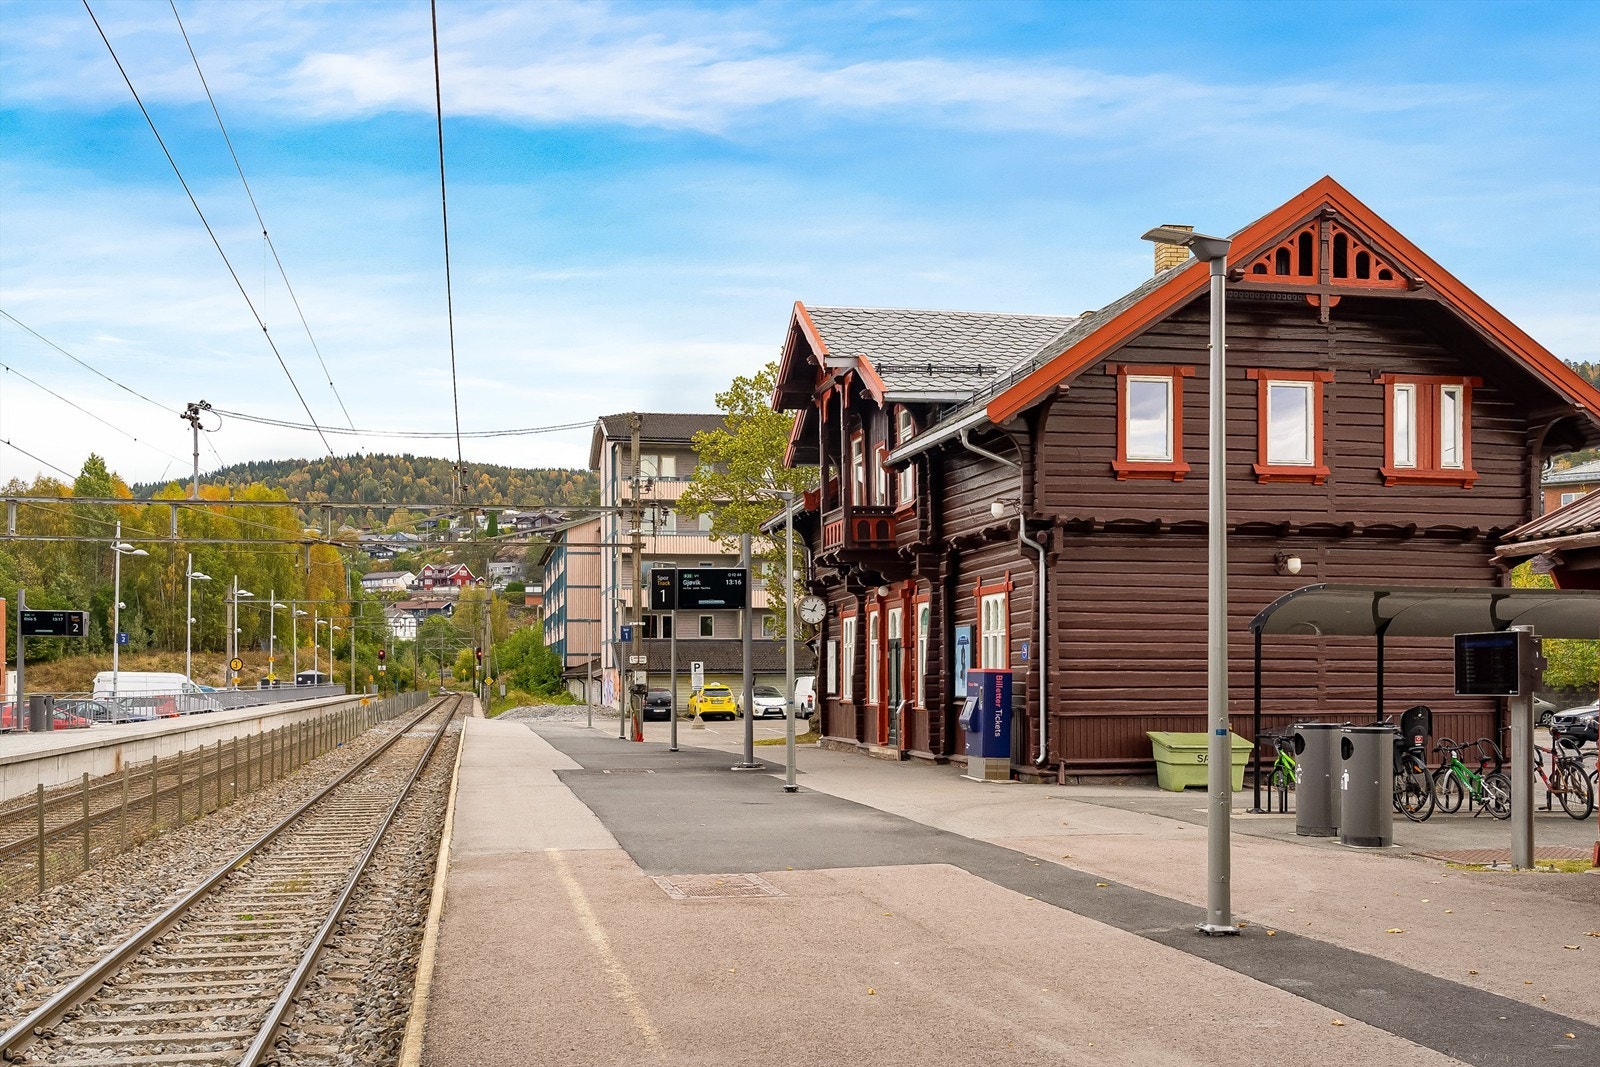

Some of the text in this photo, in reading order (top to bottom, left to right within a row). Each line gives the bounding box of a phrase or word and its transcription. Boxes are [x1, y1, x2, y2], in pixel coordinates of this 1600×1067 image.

[682, 579, 701, 587] Gjøvik
[660, 589, 666, 603] 1
[72, 623, 79, 633] 2
[624, 632, 629, 640] 1
[694, 662, 701, 673] P
[995, 675, 1003, 737] Billetter Tickets
